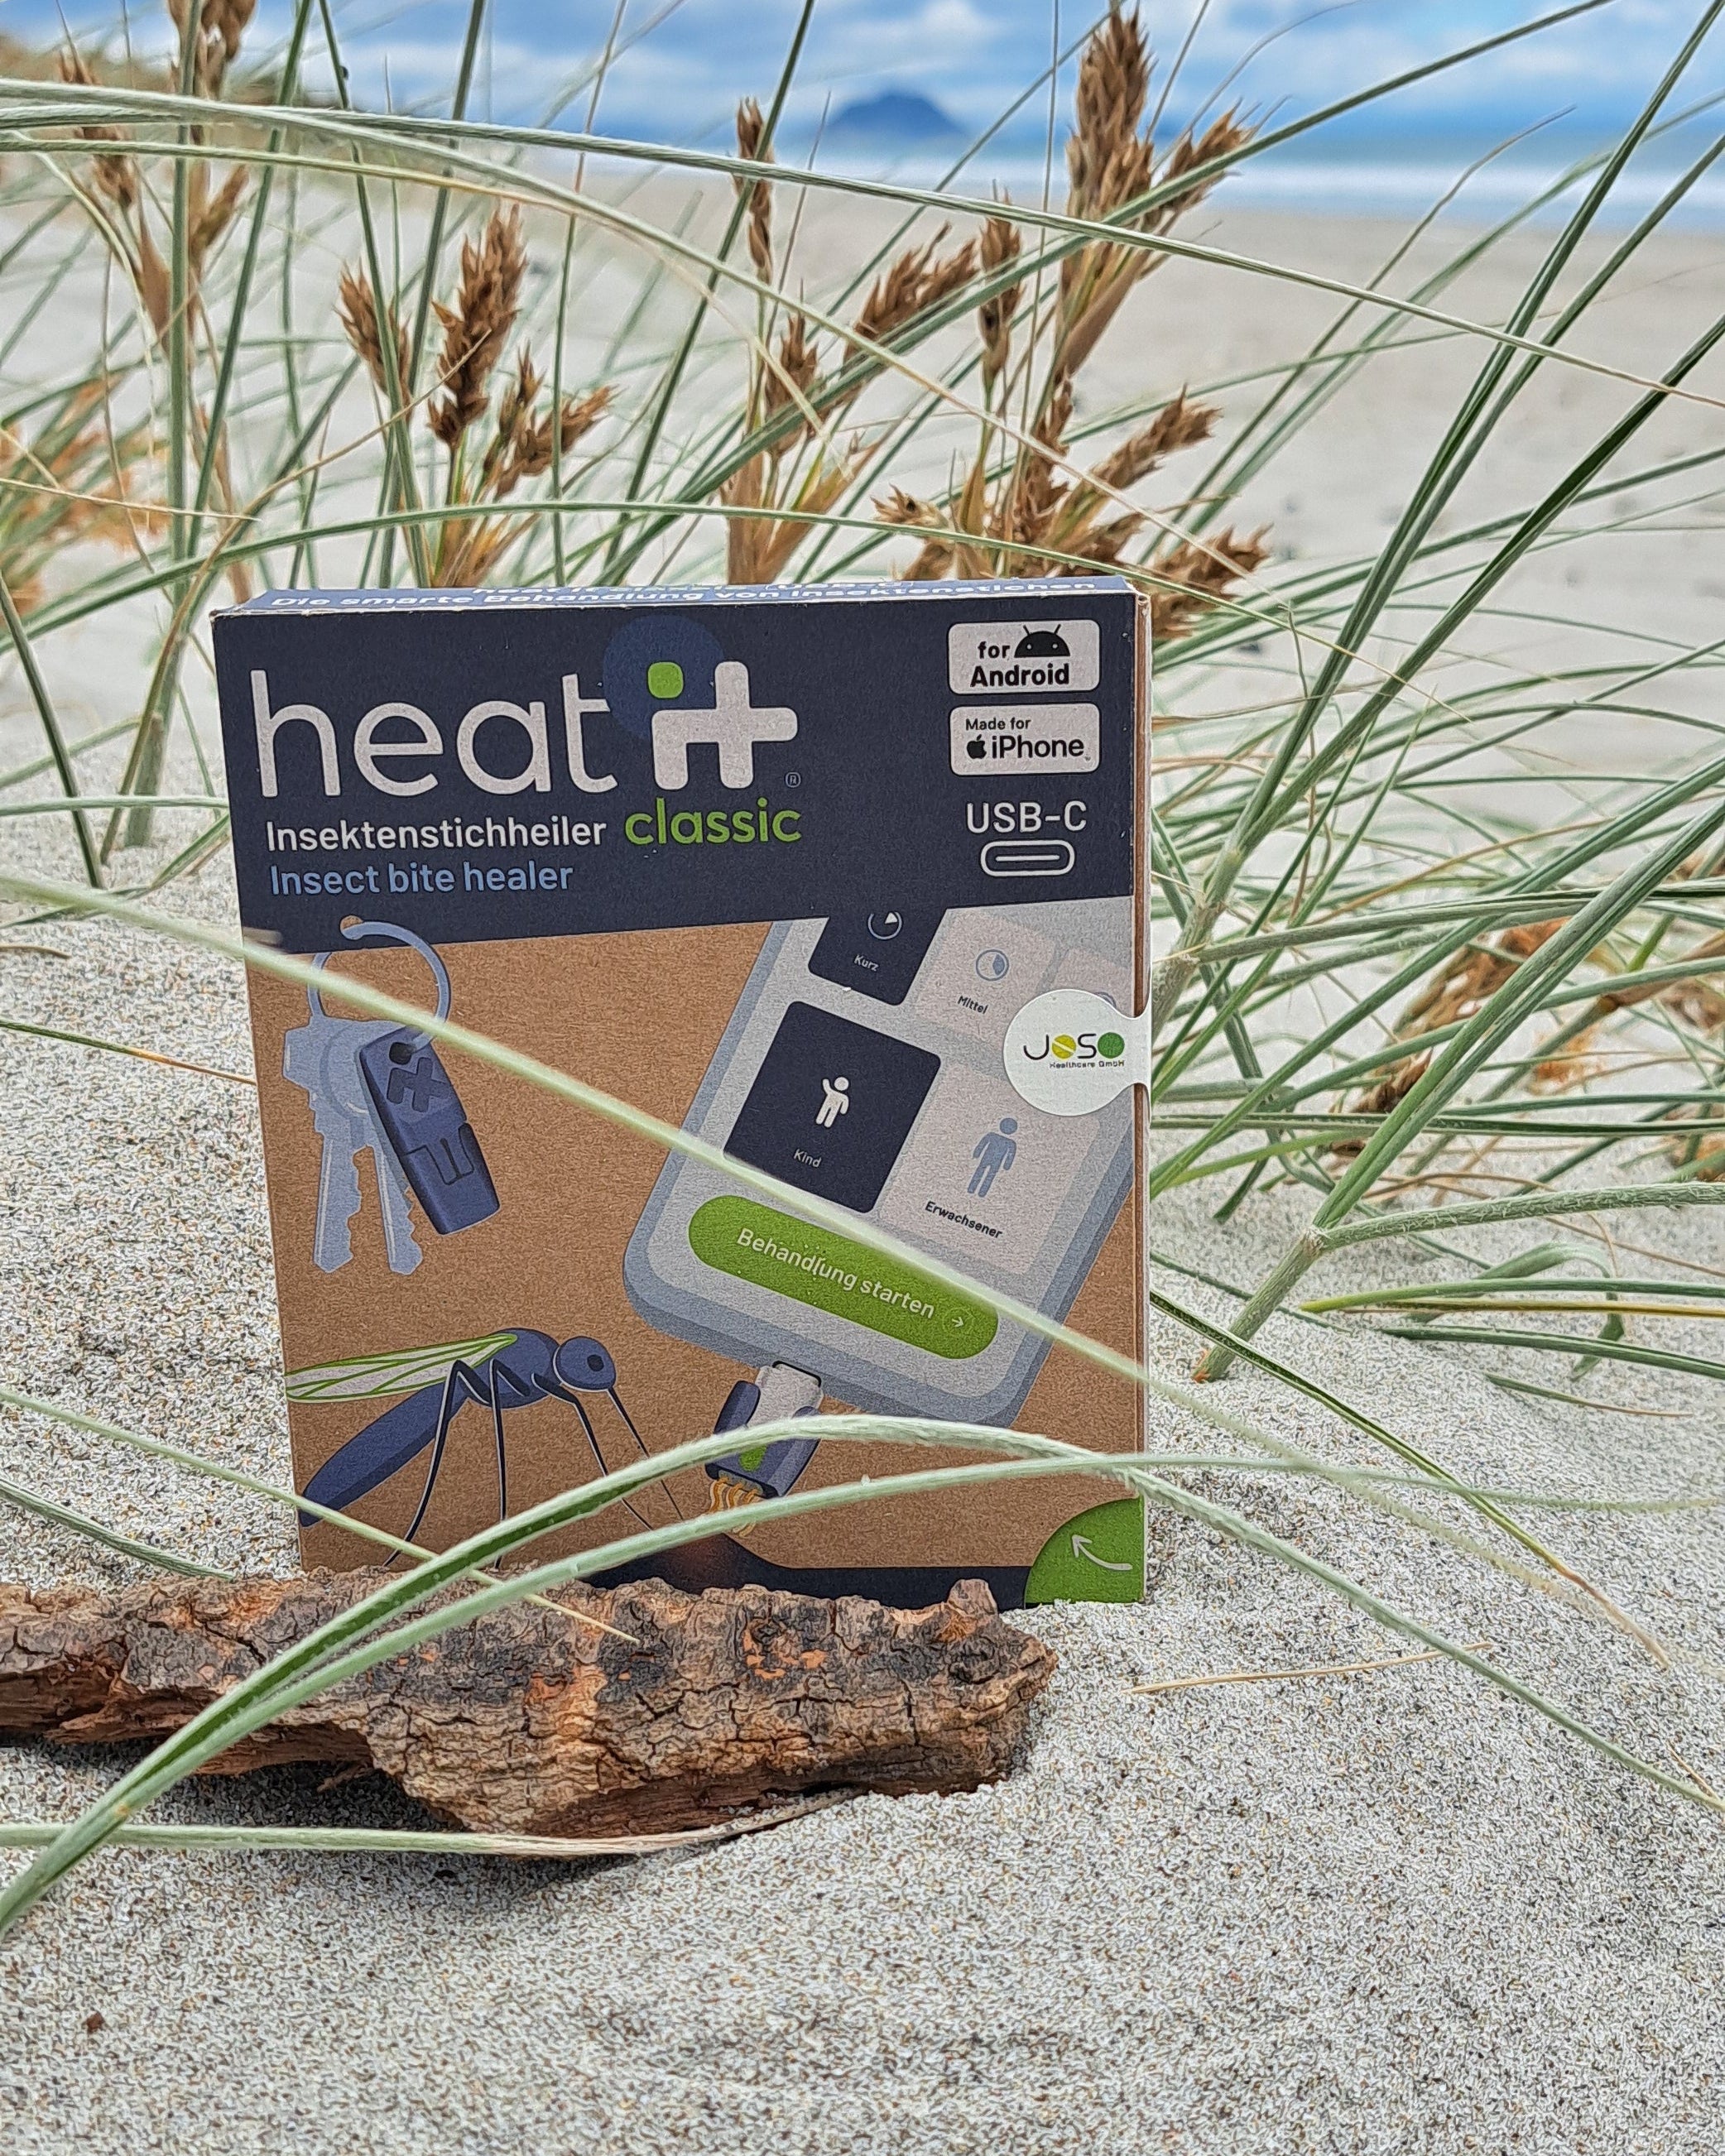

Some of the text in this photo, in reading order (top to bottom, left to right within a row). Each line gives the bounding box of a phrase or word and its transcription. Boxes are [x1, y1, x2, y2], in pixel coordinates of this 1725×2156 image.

[339, 595, 474, 605] smarte
[483, 592, 704, 603] Behandlung
[978, 641, 1010, 659] for
[970, 663, 1069, 687] Android
[251, 670, 618, 797] heat
[965, 718, 1031, 731] Made for
[992, 735, 1084, 759] iPhone
[266, 797, 801, 852] Insektenstichheiler classic
[967, 800, 1087, 833] USB-C
[270, 859, 574, 895] Insect bite healer
[853, 954, 880, 972] Kurz
[958, 995, 989, 1015] Mittel
[793, 1149, 822, 1168] Kind
[925, 1200, 1003, 1240] Erwachsener
[737, 1227, 935, 1319] Behandlung starten
